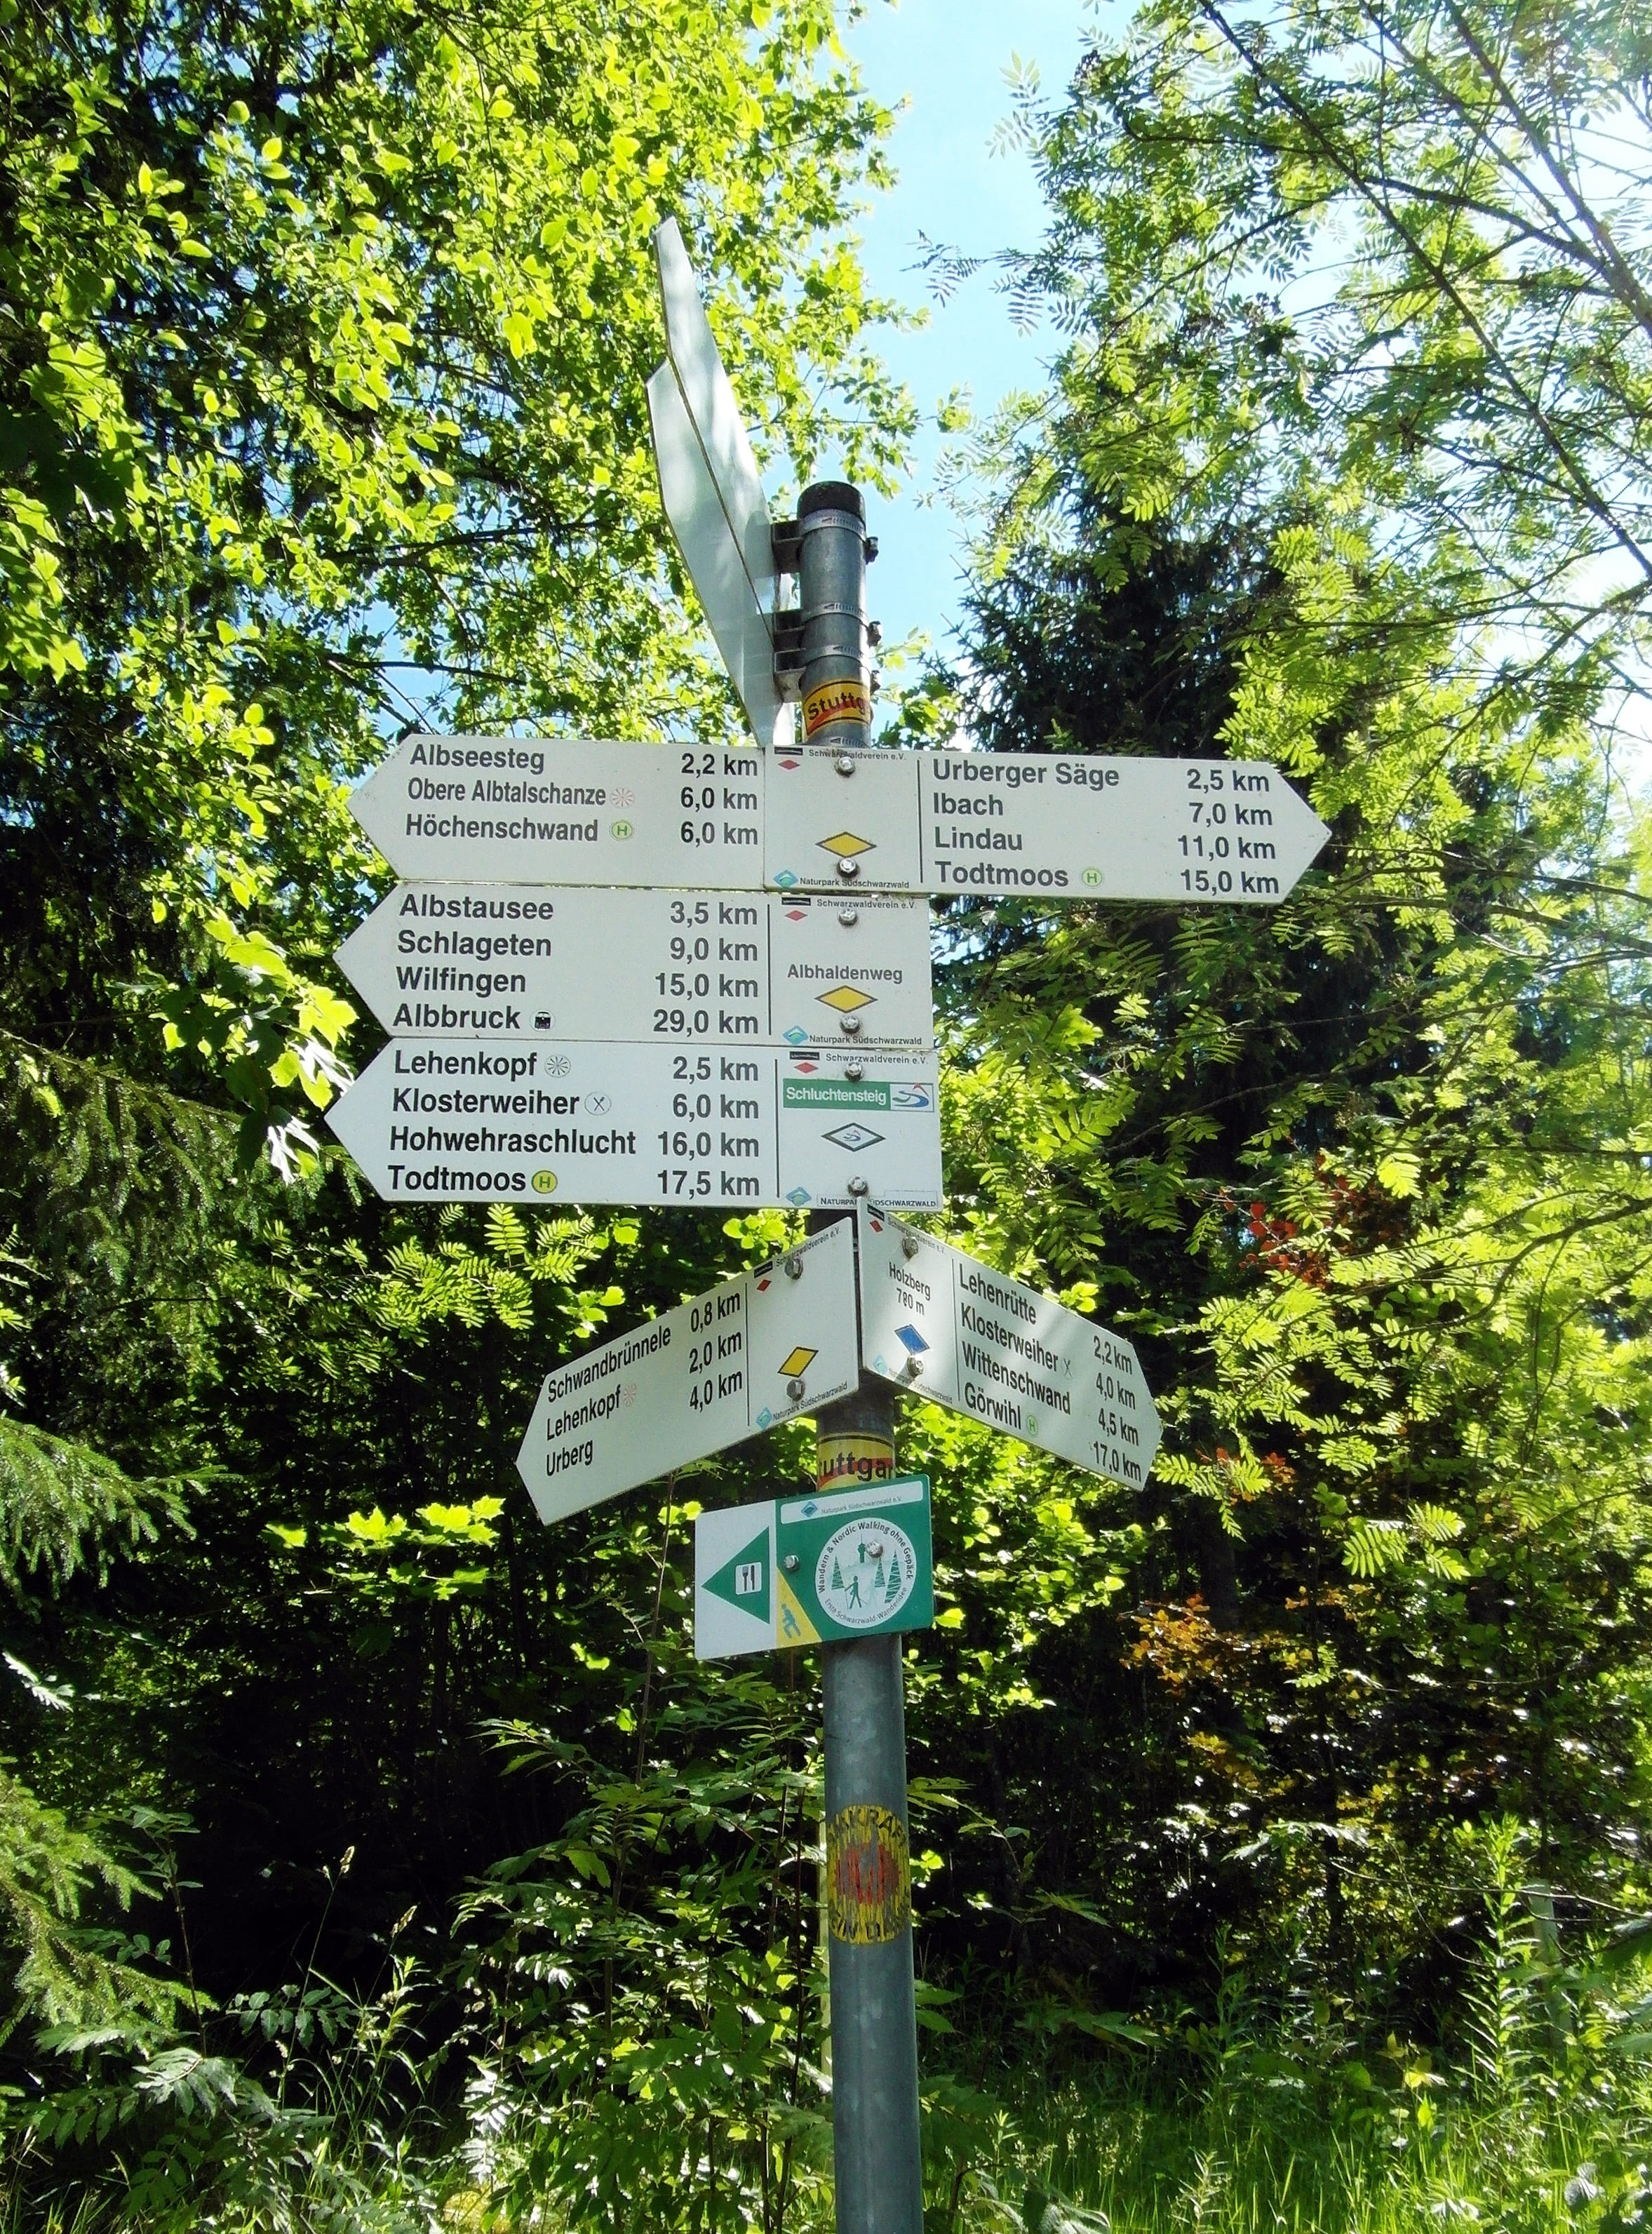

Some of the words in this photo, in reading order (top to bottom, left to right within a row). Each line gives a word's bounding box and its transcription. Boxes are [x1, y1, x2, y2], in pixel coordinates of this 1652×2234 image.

[409, 743, 544, 775] Albseesteg
[681, 752, 715, 779] 2,2
[723, 754, 758, 776] km
[933, 758, 1047, 789] Urberger
[1055, 762, 1120, 791] Säge
[1186, 768, 1224, 794] 2,5
[1232, 770, 1270, 792] km
[408, 777, 466, 801] Obere
[471, 780, 606, 805] Albtalschanze
[680, 786, 715, 812] 6,0
[723, 787, 758, 810] km
[933, 792, 1003, 816] Ibach
[1188, 802, 1226, 828] 7,0
[1235, 803, 1272, 826] km
[405, 813, 598, 842] Höchenschwand
[680, 821, 715, 848] 6,0
[723, 822, 758, 845] km
[934, 826, 1023, 851] Lindau
[1178, 834, 1230, 862] 11,0
[1237, 836, 1276, 860] km
[800, 877, 840, 887] Naturpark
[841, 878, 910, 889] Südschwarzwald
[934, 860, 1069, 887] Todtmoos
[1180, 869, 1233, 897] 15,0
[1240, 871, 1280, 894] km
[398, 893, 553, 920] Albstausee
[670, 901, 709, 928] 3,5
[718, 902, 758, 925] km
[817, 899, 899, 909] Schwarzwaldverein
[397, 929, 551, 961] Schlageten
[670, 937, 709, 965] 9,0
[719, 937, 758, 961] km
[396, 965, 526, 998] Wilfingen
[655, 972, 710, 1001] 15,0
[719, 973, 758, 998] km
[787, 963, 903, 985] Albhaldenweg
[392, 1003, 521, 1029] Albbruck
[653, 1008, 709, 1038] 29,0
[718, 1010, 758, 1034] km
[810, 1035, 851, 1045] Naturpark
[852, 1036, 922, 1045] Südschwarzwald
[395, 1050, 537, 1083] Lehenkopf
[673, 1056, 711, 1085] 2,5
[720, 1057, 758, 1081] km
[826, 1053, 910, 1064] Schwarzwaldverein
[393, 1088, 580, 1115] Klosterweiher
[673, 1093, 711, 1123] 6,0
[720, 1094, 759, 1119] km
[786, 1087, 887, 1105] Schluchtensteig
[390, 1125, 636, 1154] Hohwehraschlucht
[657, 1130, 711, 1161] 16,0
[720, 1132, 759, 1158] km
[387, 1165, 526, 1191] Todtmoos
[657, 1170, 711, 1200] 17,5
[720, 1170, 760, 1196] km
[889, 1262, 931, 1301] Holzberg
[896, 1288, 913, 1309] 780
[915, 1301, 925, 1316] m
[959, 1264, 1036, 1325] Lehenrütte
[1094, 1336, 1112, 1366] 2,2
[1113, 1351, 1133, 1374] km
[549, 1325, 671, 1403] Schwandbrünnele
[690, 1306, 713, 1332] 0,8
[718, 1292, 741, 1318] km
[961, 1303, 1059, 1372] Klosterweiher
[1095, 1372, 1114, 1400] 4,0
[1115, 1387, 1136, 1410] km
[546, 1385, 621, 1441] Lehenkopf
[690, 1344, 713, 1373] 2,0
[718, 1331, 742, 1357] km
[962, 1341, 1071, 1415] Wittenschwand
[1097, 1408, 1117, 1436] 4,5
[1119, 1423, 1139, 1446] km
[546, 1440, 593, 1477] Urberg
[690, 1385, 713, 1413] 4,0
[719, 1370, 743, 1396] km
[965, 1382, 1021, 1430] Görwihl
[1093, 1441, 1119, 1474] 17,0
[1122, 1459, 1142, 1482] km
[818, 1555, 829, 1593] Wandern
[832, 1526, 857, 1546] Nordic
[858, 1521, 889, 1534] Walking
[890, 1530, 906, 1547] ohne
[904, 1548, 913, 1580] Gepäck
